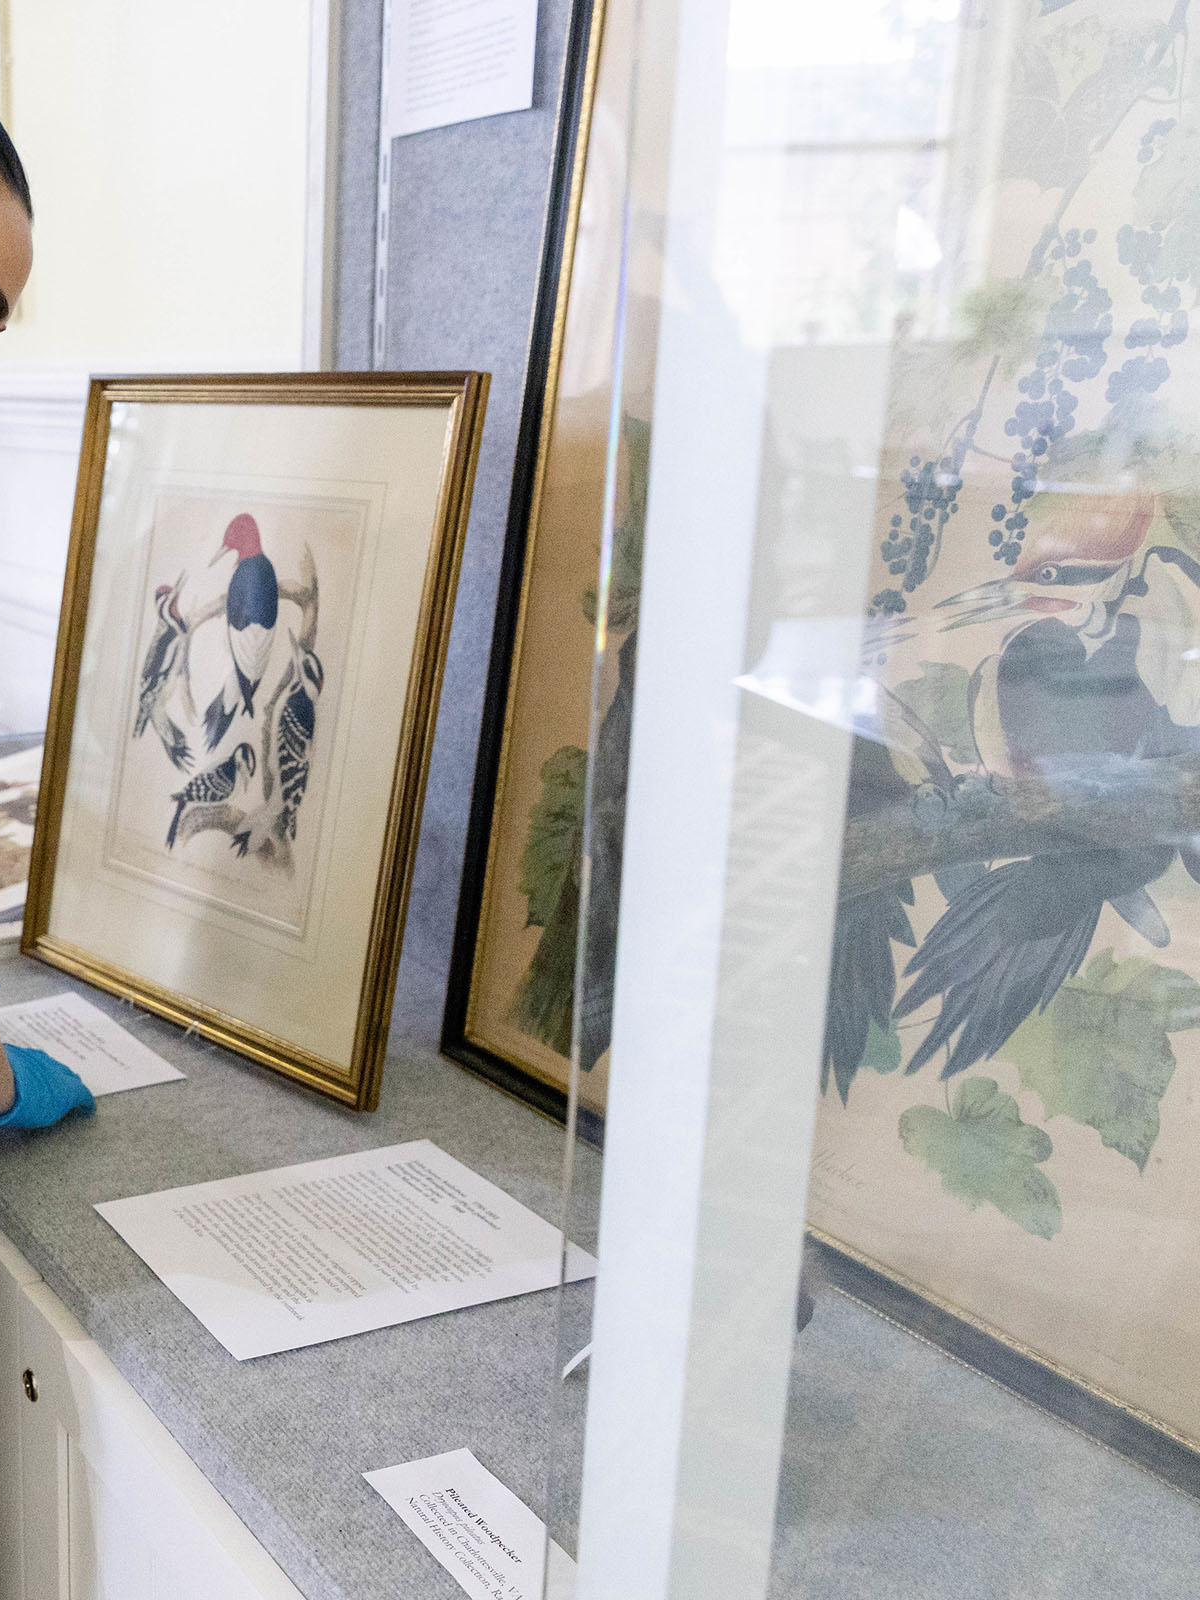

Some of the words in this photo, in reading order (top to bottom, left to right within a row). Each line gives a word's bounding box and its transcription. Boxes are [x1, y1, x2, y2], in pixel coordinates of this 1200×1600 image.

[405, 1497, 434, 1523] Natural
[429, 1524, 456, 1551] History
[455, 1551, 490, 1590] Collection,
[420, 1494, 453, 1527] Collected
[448, 1527, 458, 1536] in
[457, 1535, 506, 1587] Charlottesville,
[445, 1488, 478, 1518] Pileated
[475, 1517, 522, 1563] Woodpecker
